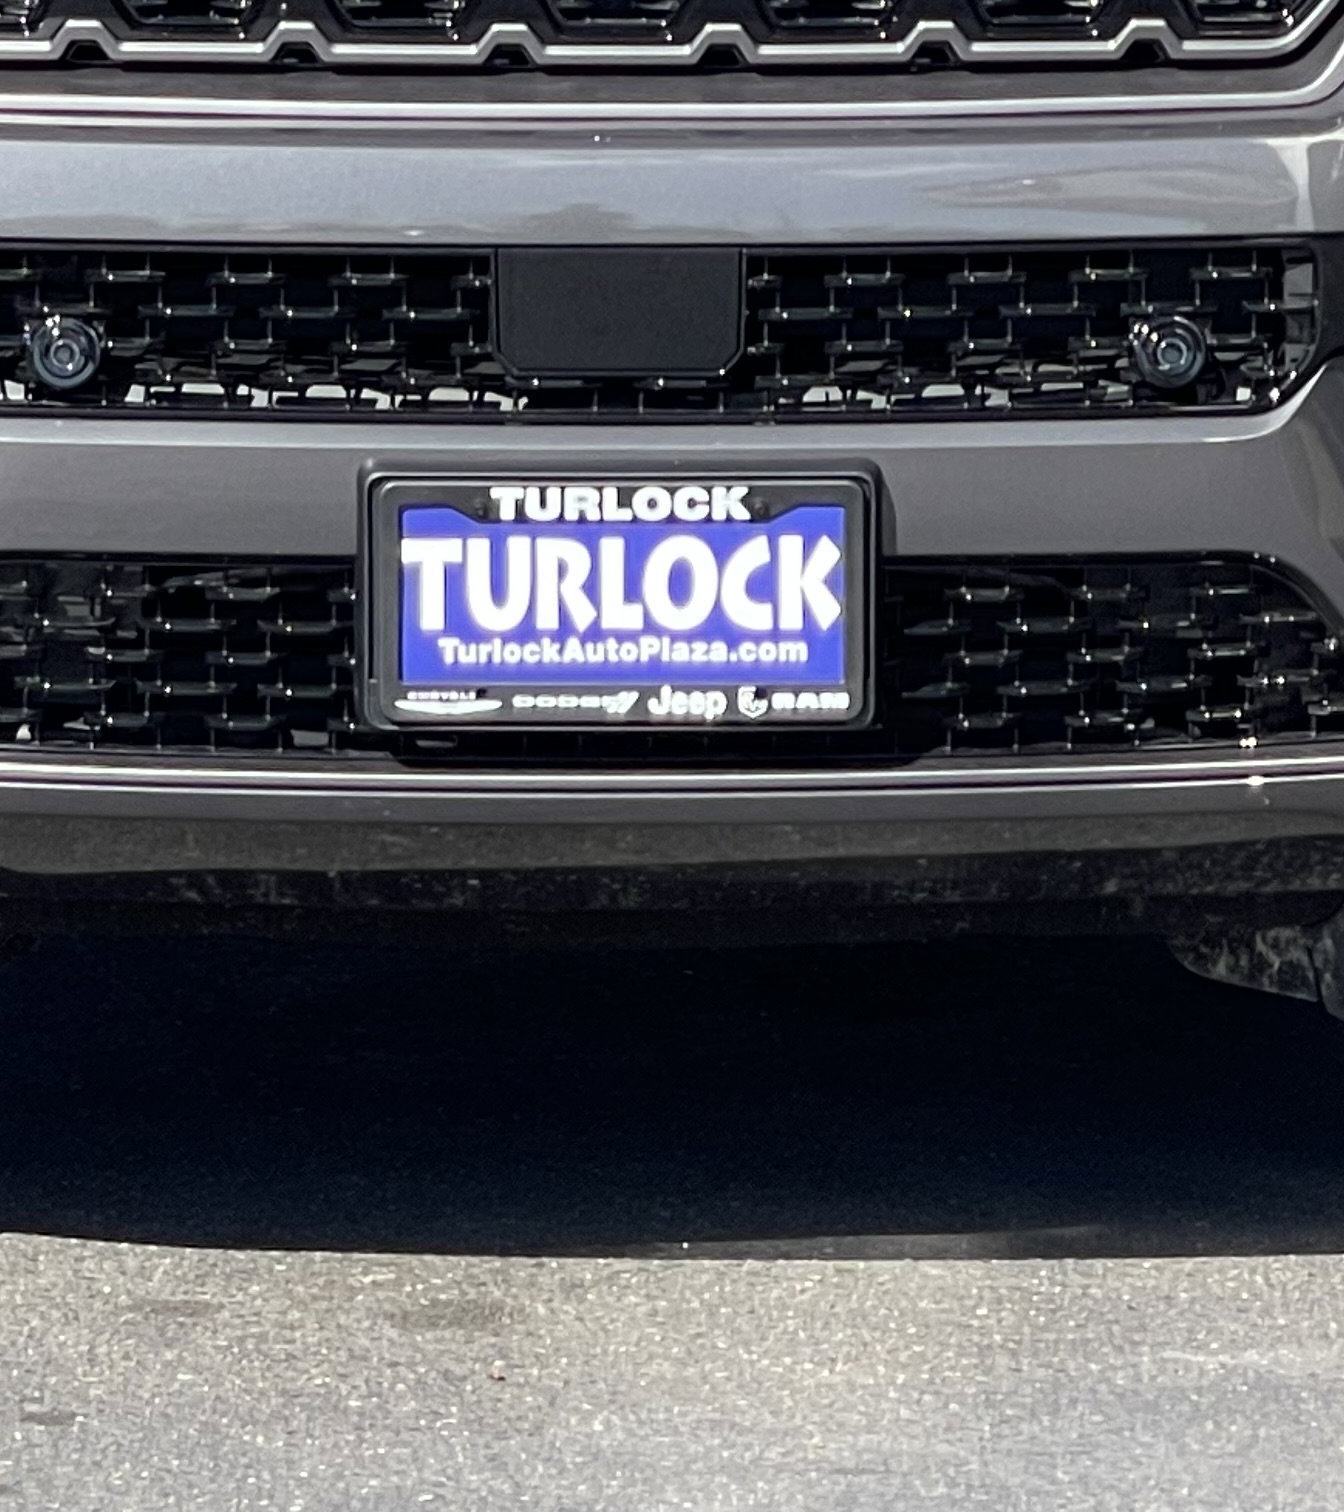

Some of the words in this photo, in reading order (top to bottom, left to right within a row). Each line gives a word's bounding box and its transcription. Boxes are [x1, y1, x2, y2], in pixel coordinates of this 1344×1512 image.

[490, 486, 751, 521] TURLOCK
[401, 535, 842, 632] TURLOCK
[438, 637, 809, 665] TurlockAutoPlaza.com
[647, 685, 728, 721] Jeep
